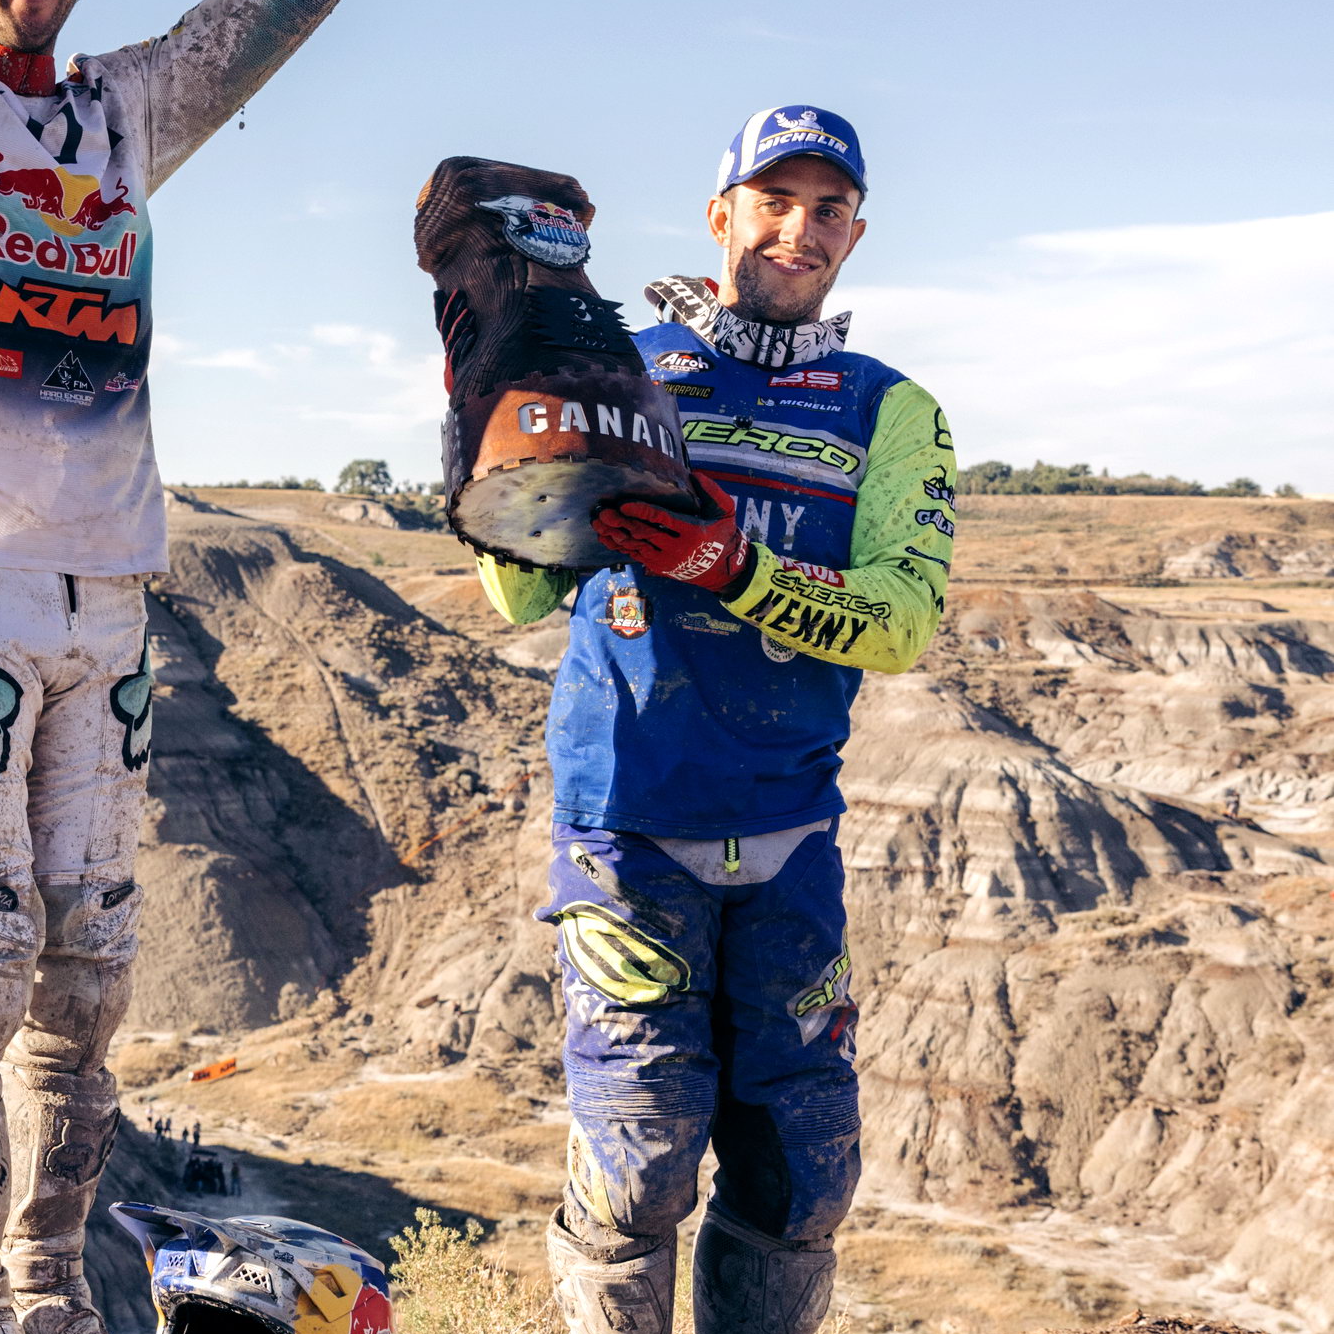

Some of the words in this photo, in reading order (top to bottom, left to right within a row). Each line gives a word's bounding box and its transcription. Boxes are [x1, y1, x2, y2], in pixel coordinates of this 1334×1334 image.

[757, 132, 849, 155] MICHELIN
[527, 211, 556, 228] Red
[556, 218, 585, 233] Bull
[533, 223, 586, 244] OUTLIERS
[69, 231, 138, 279] Bull
[74, 380, 88, 389] FIM
[771, 371, 839, 386] BS
[40, 390, 63, 398] HARD
[779, 399, 842, 412] MICHELIN
[518, 401, 684, 463] CANAD
[682, 419, 861, 475] ERCO
[775, 555, 840, 584] MTUL
[770, 568, 892, 620] SHERCO
[745, 588, 868, 654] KENNY
